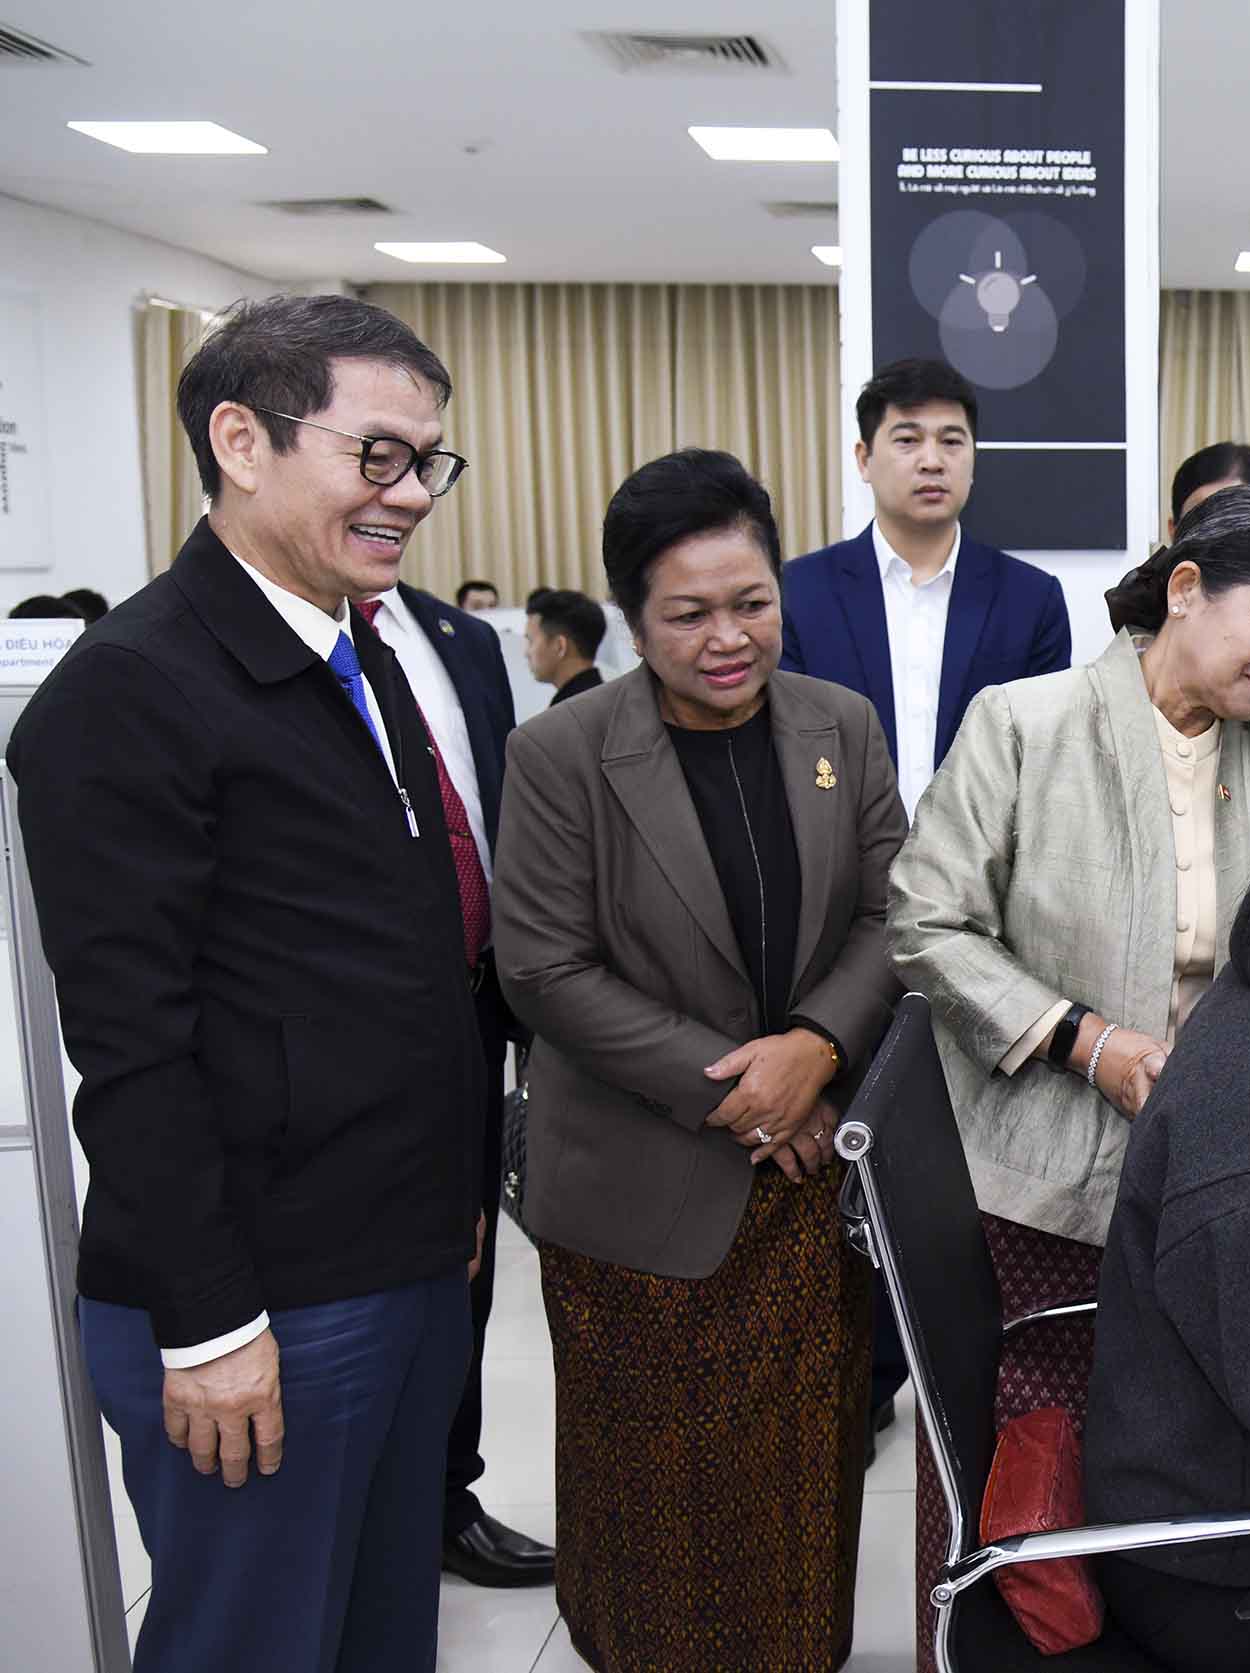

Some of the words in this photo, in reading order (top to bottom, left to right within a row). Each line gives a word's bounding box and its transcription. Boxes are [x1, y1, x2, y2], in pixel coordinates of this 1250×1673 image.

[902, 148, 918, 162] BE
[920, 148, 948, 163] LESS
[949, 149, 1001, 163] CURIOUS
[1002, 150, 1044, 164] ABOUT
[1046, 150, 1091, 164] PEOPLE
[897, 164, 925, 178] AND
[926, 165, 964, 178] MORE
[965, 165, 1018, 179] CURIOUS
[1019, 166, 1060, 180] ABOUT
[1061, 167, 1096, 181] IDEAS
